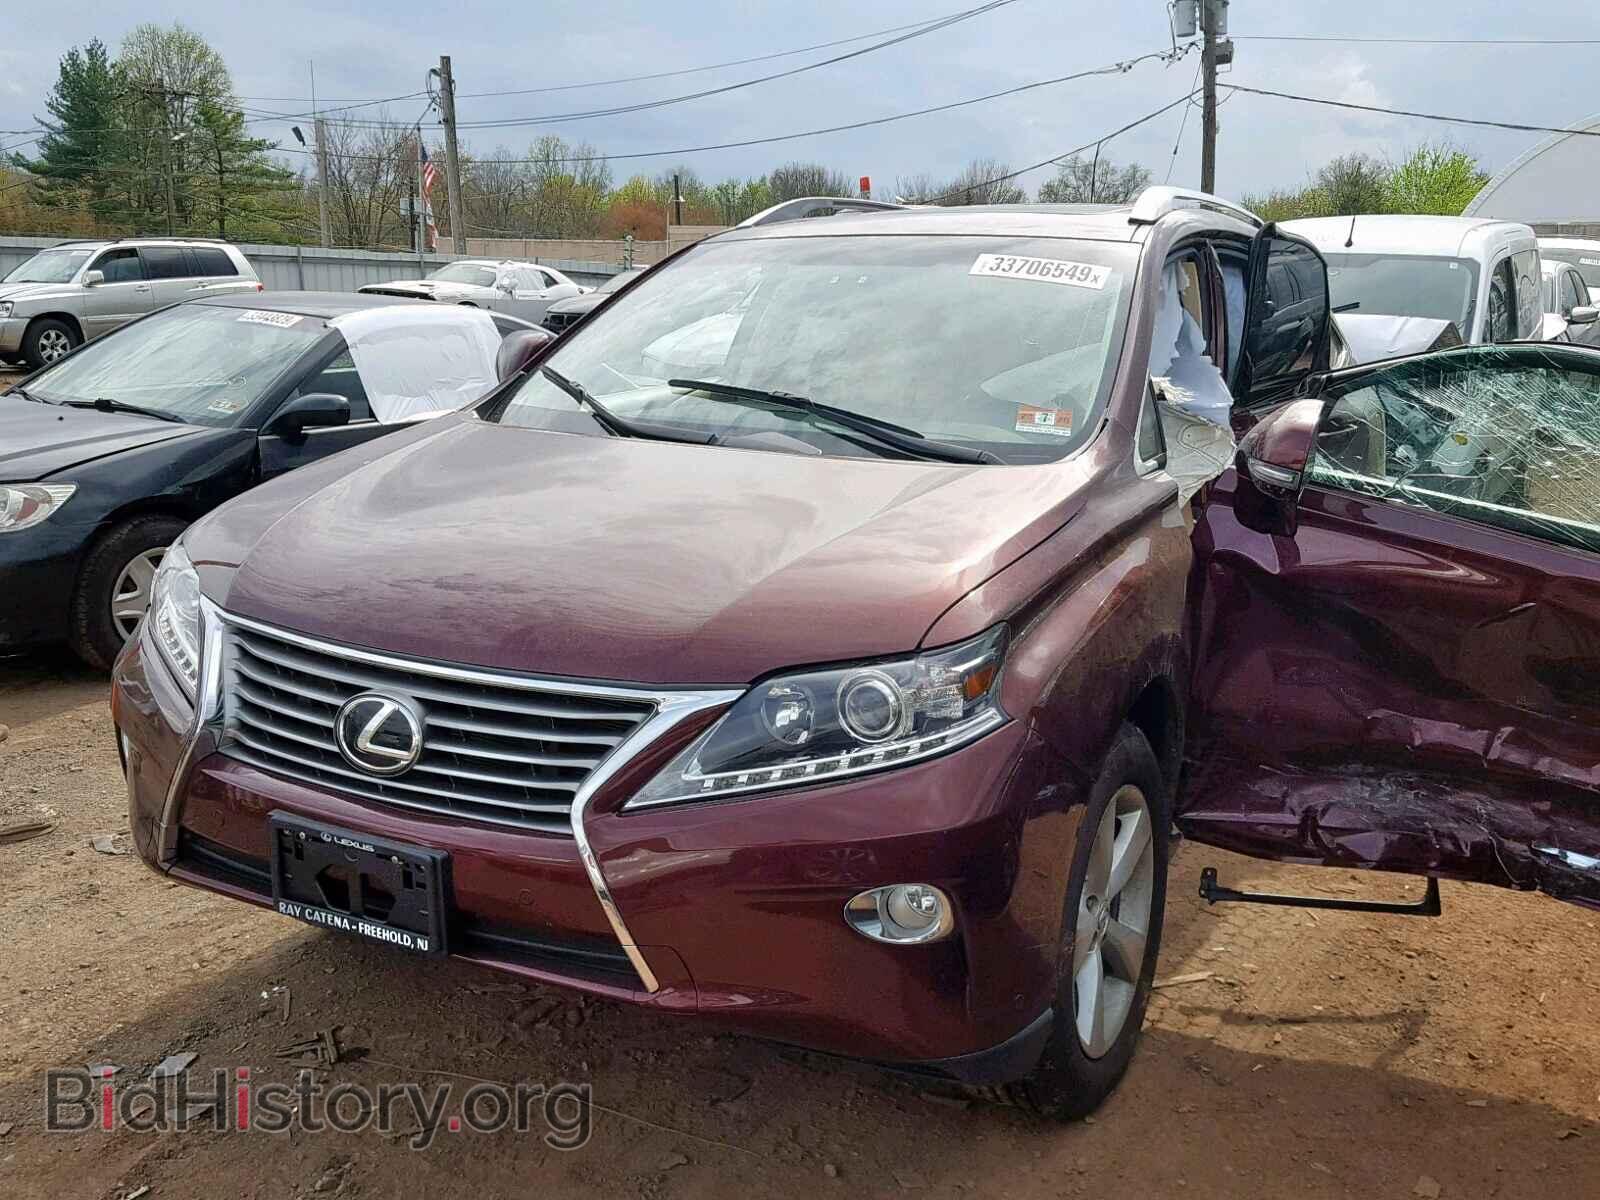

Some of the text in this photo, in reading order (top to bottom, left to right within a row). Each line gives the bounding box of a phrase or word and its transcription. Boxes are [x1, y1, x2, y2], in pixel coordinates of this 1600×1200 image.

[333, 836, 375, 852] LEXUS
[278, 902, 301, 918] RAY
[305, 908, 351, 931] CATENA
[358, 922, 415, 949] FREEHOLD,
[416, 938, 429, 951] NJ
